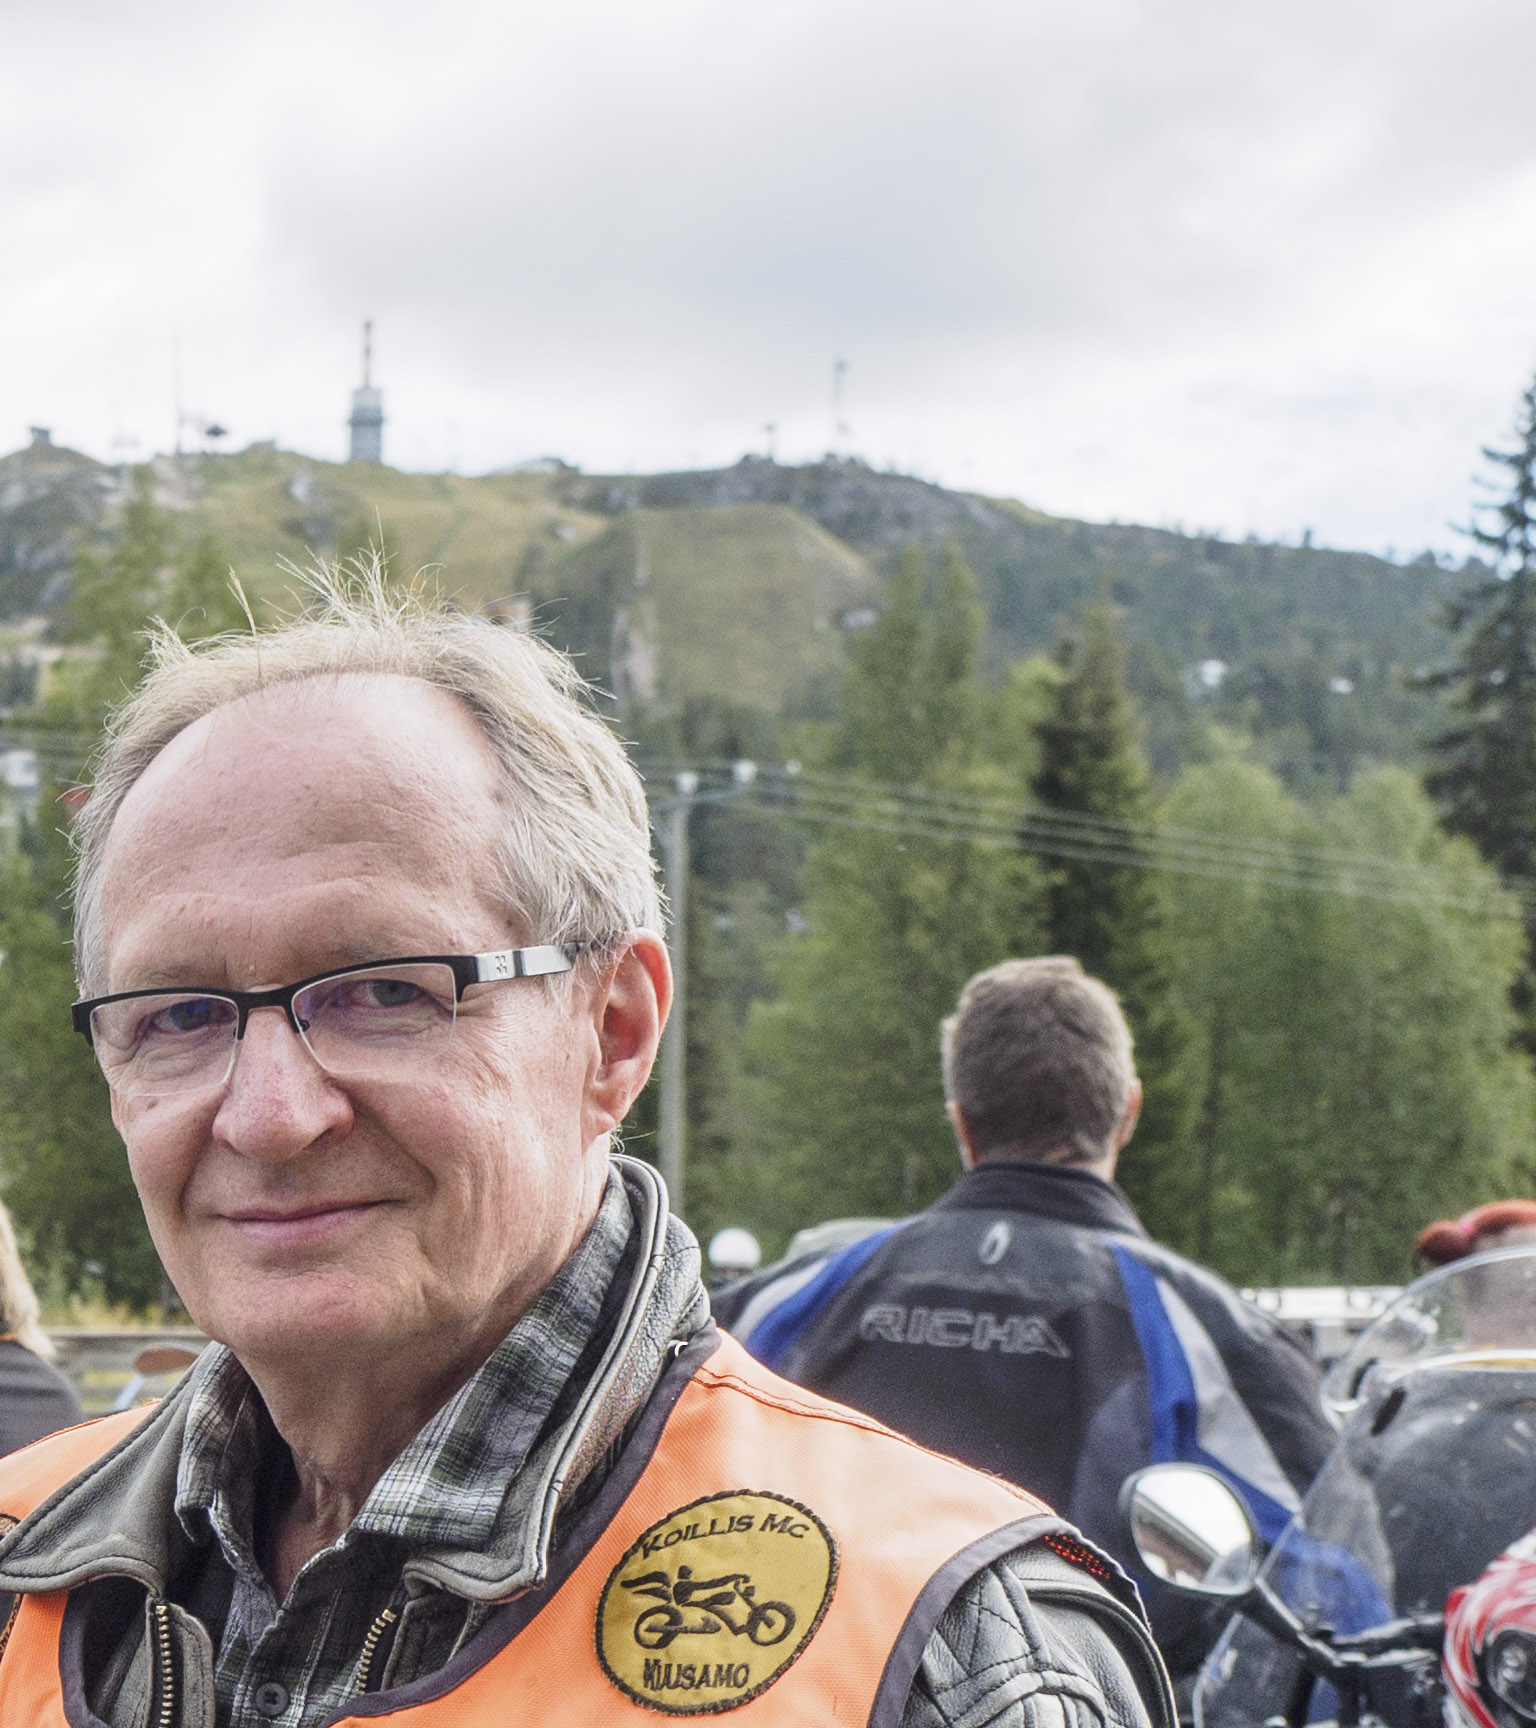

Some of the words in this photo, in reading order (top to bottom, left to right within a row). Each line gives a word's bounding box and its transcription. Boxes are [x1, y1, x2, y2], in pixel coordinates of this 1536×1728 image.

[859, 1302, 1071, 1359] RICHA
[642, 1514, 755, 1559] KOILLIS
[643, 1658, 751, 1691] KUUSAMO
